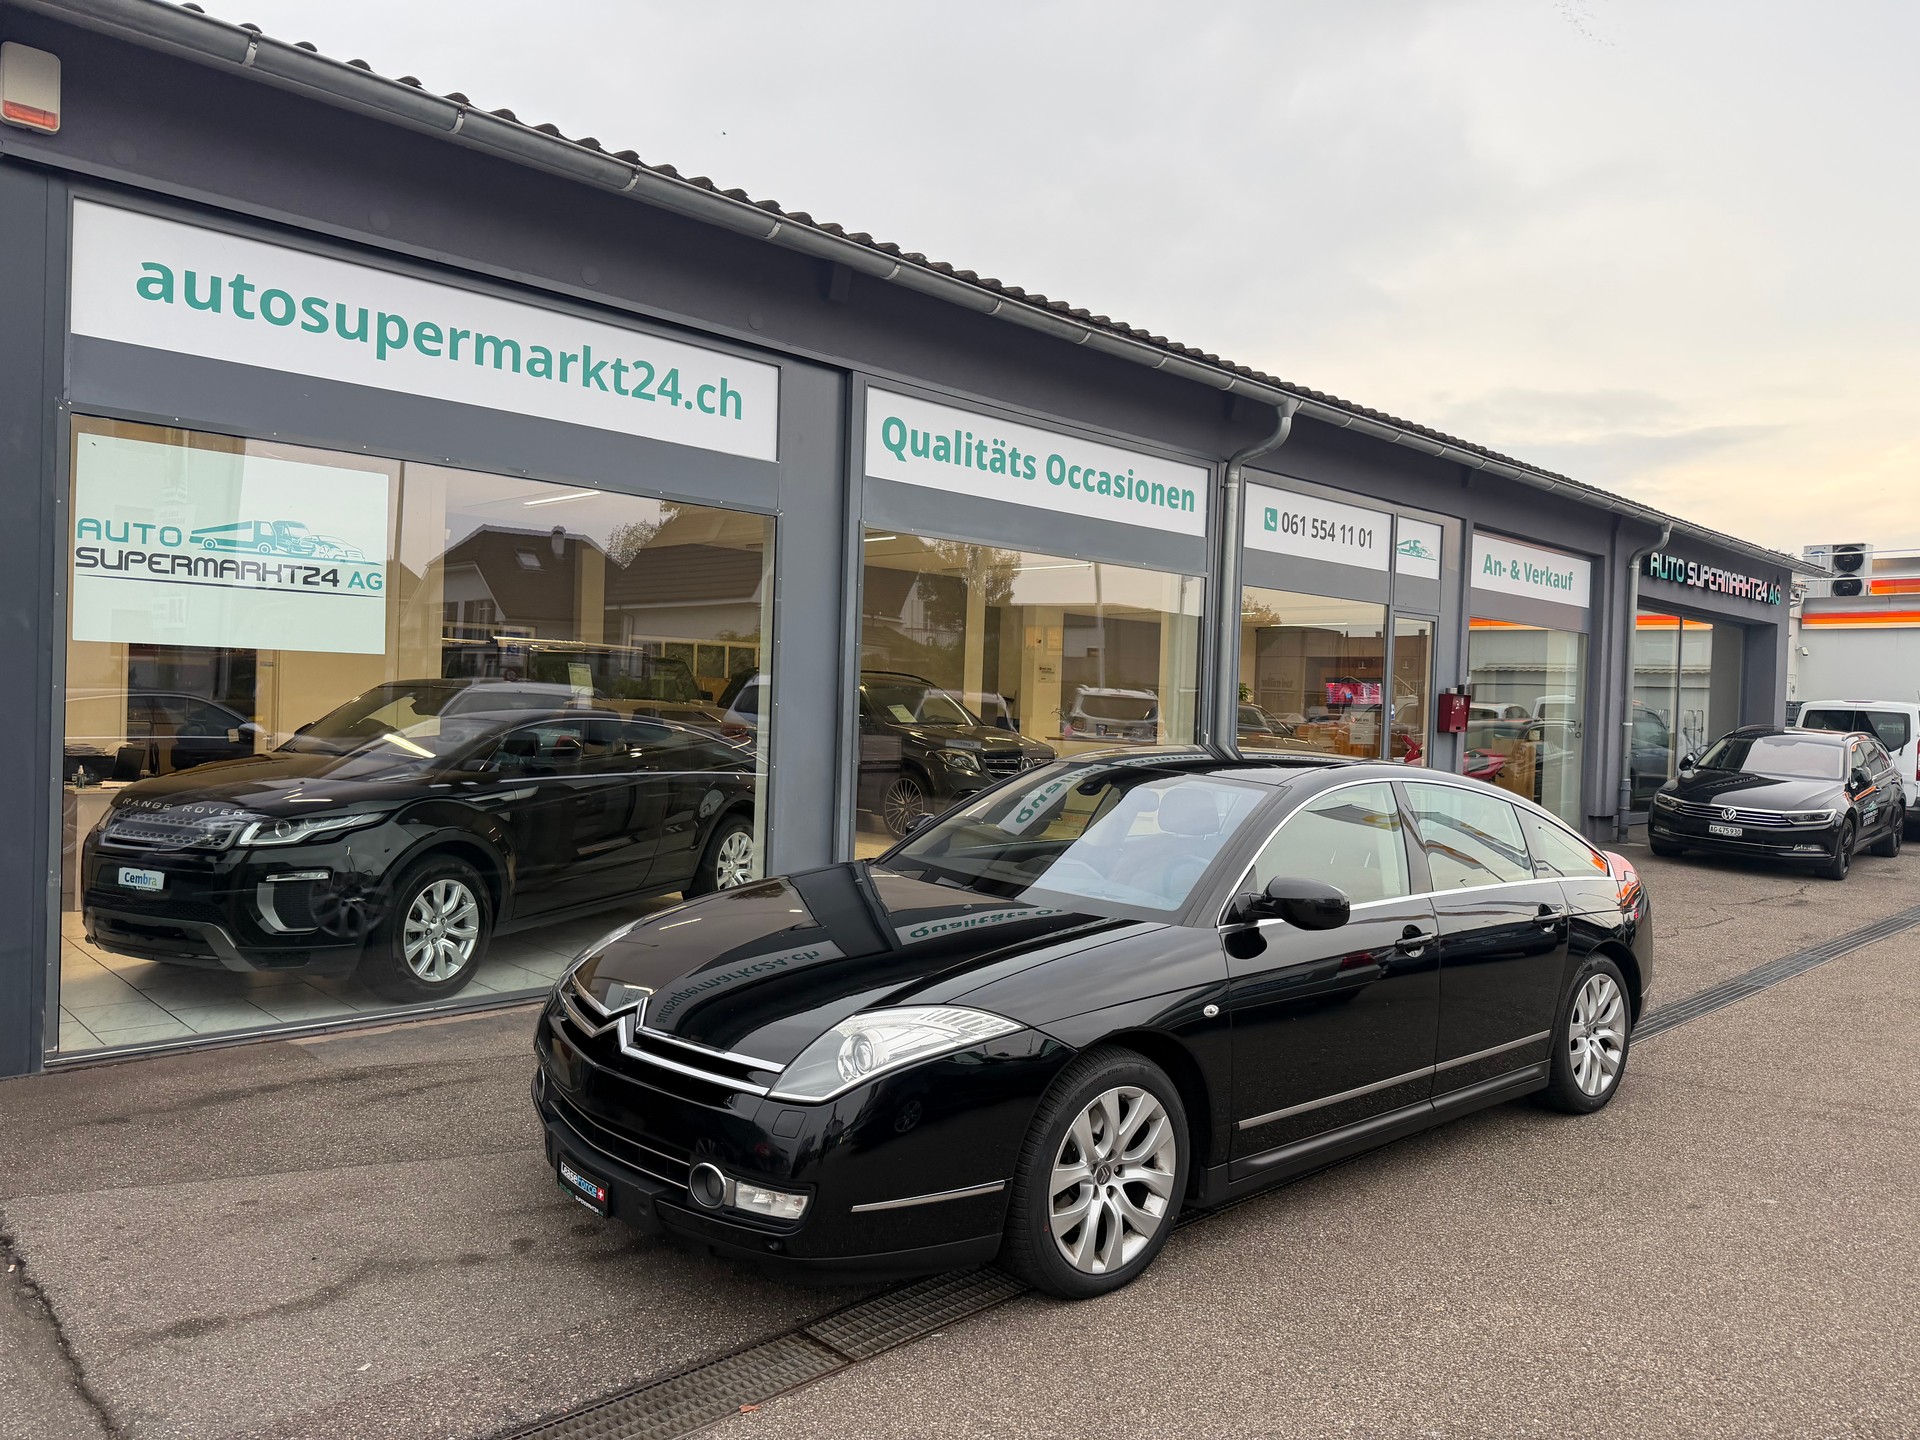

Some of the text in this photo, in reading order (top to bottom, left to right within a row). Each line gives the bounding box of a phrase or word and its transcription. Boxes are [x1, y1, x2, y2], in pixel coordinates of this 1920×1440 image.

[136, 261, 743, 420] autosupermarkt24.ch
[881, 416, 1195, 512] Qualitäts Occasionen
[77, 518, 183, 547] AUTO
[1281, 511, 1373, 549] 061 554 11 01
[75, 546, 383, 590] SUPERMARKT24 AG
[1483, 554, 1574, 591] An- & Verkauf
[1650, 551, 1781, 605] AUTO SUPERMARKT24 AG
[122, 797, 245, 816] RANGE ROVER
[124, 872, 158, 887] Cembra
